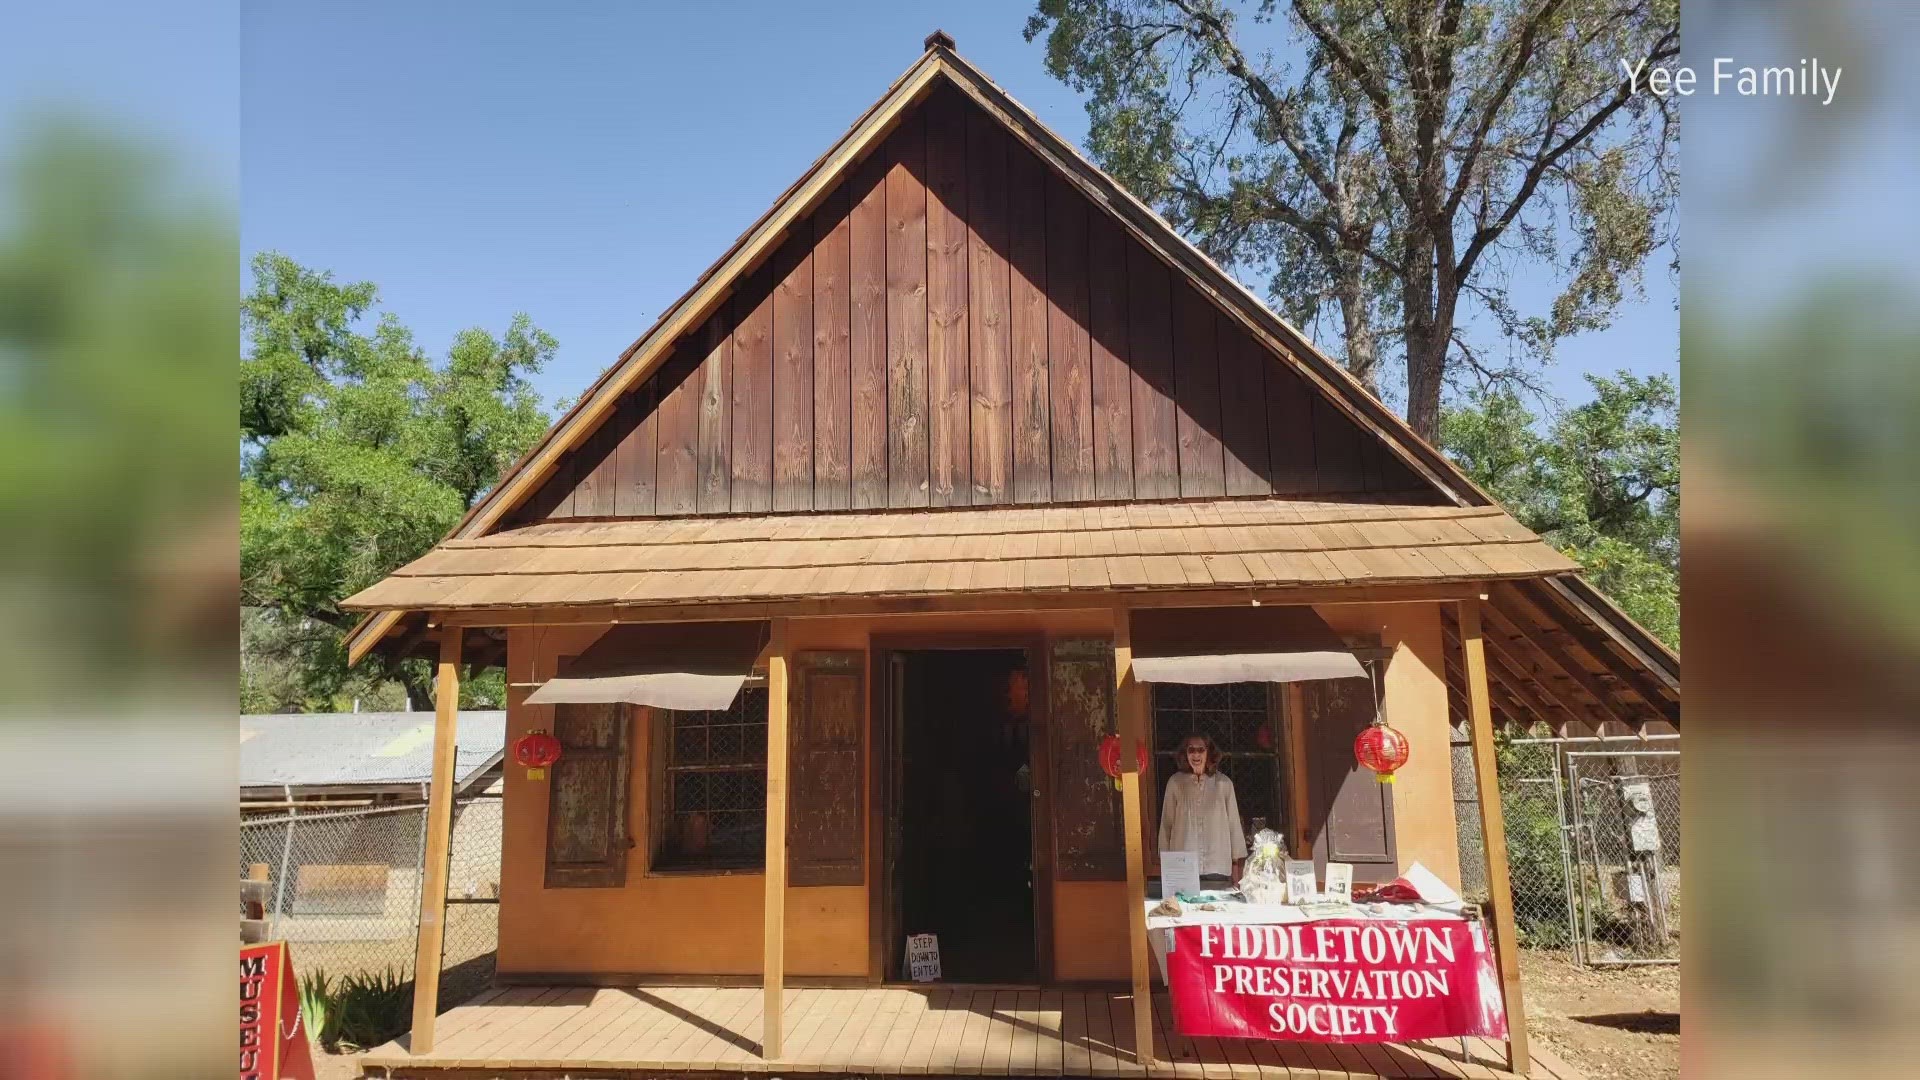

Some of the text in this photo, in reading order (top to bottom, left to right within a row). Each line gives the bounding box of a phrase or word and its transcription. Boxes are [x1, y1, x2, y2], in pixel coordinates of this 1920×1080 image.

[913, 937, 933, 949] STEP
[1199, 924, 1457, 965] FIDDLETOWN
[913, 964, 938, 977] ENTER
[1213, 964, 1451, 1001] PRESERVATION
[1267, 1002, 1399, 1036] SOCIETY
